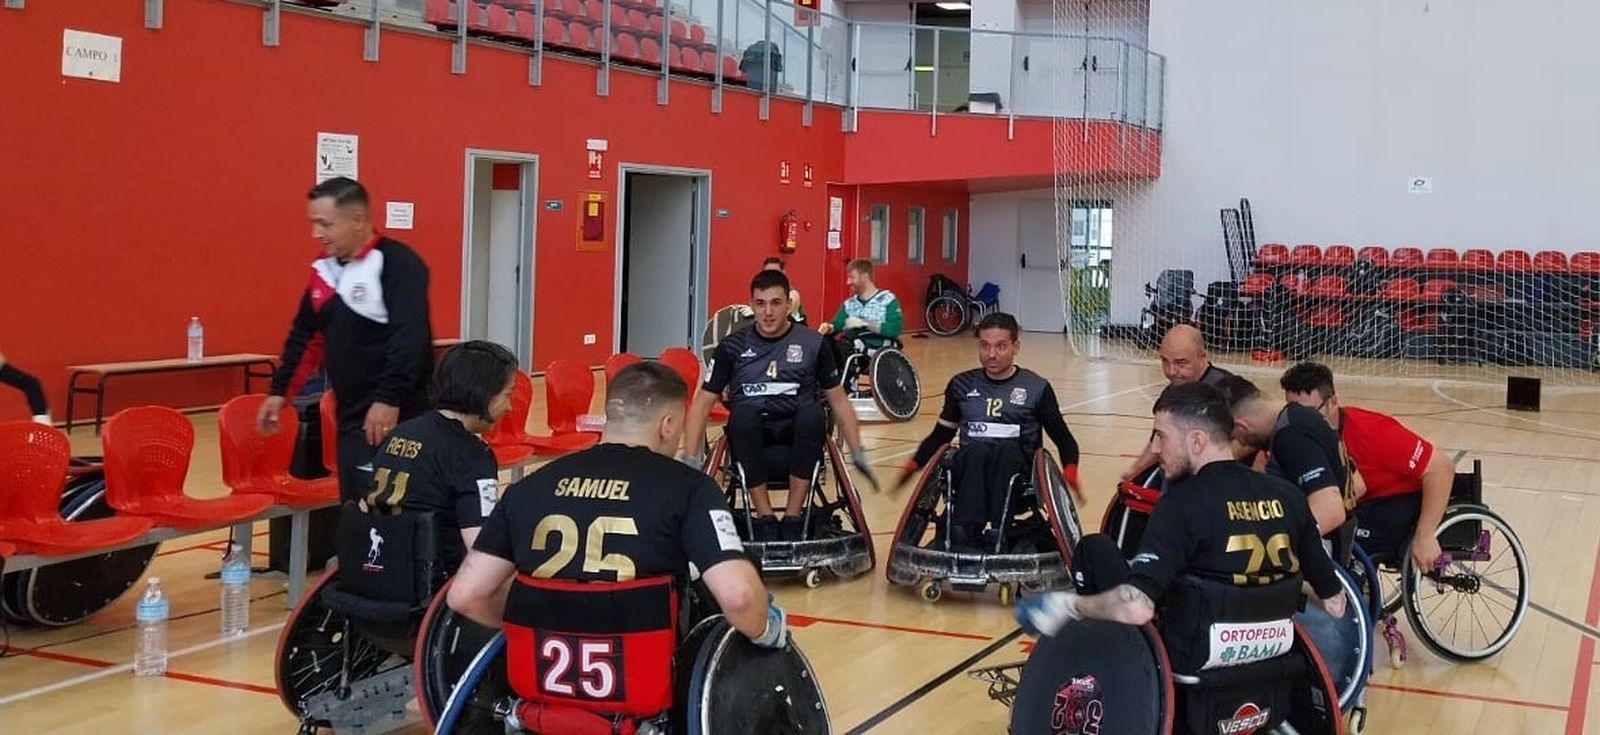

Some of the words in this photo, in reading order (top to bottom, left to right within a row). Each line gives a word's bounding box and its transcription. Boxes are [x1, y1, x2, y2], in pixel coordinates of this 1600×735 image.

[65, 46, 108, 61] CAMPO
[766, 360, 778, 379] 4
[986, 398, 1003, 417] 12
[385, 436, 422, 459] REYES
[367, 467, 410, 515] 11
[555, 477, 630, 500] SAMUEL
[1226, 499, 1285, 521] ASENCIO
[531, 514, 638, 583] 25
[1220, 627, 1288, 642] ORTOPEDIA
[1238, 643, 1283, 660] BAMI
[542, 638, 614, 698] 25
[1219, 709, 1270, 734] VESCO
